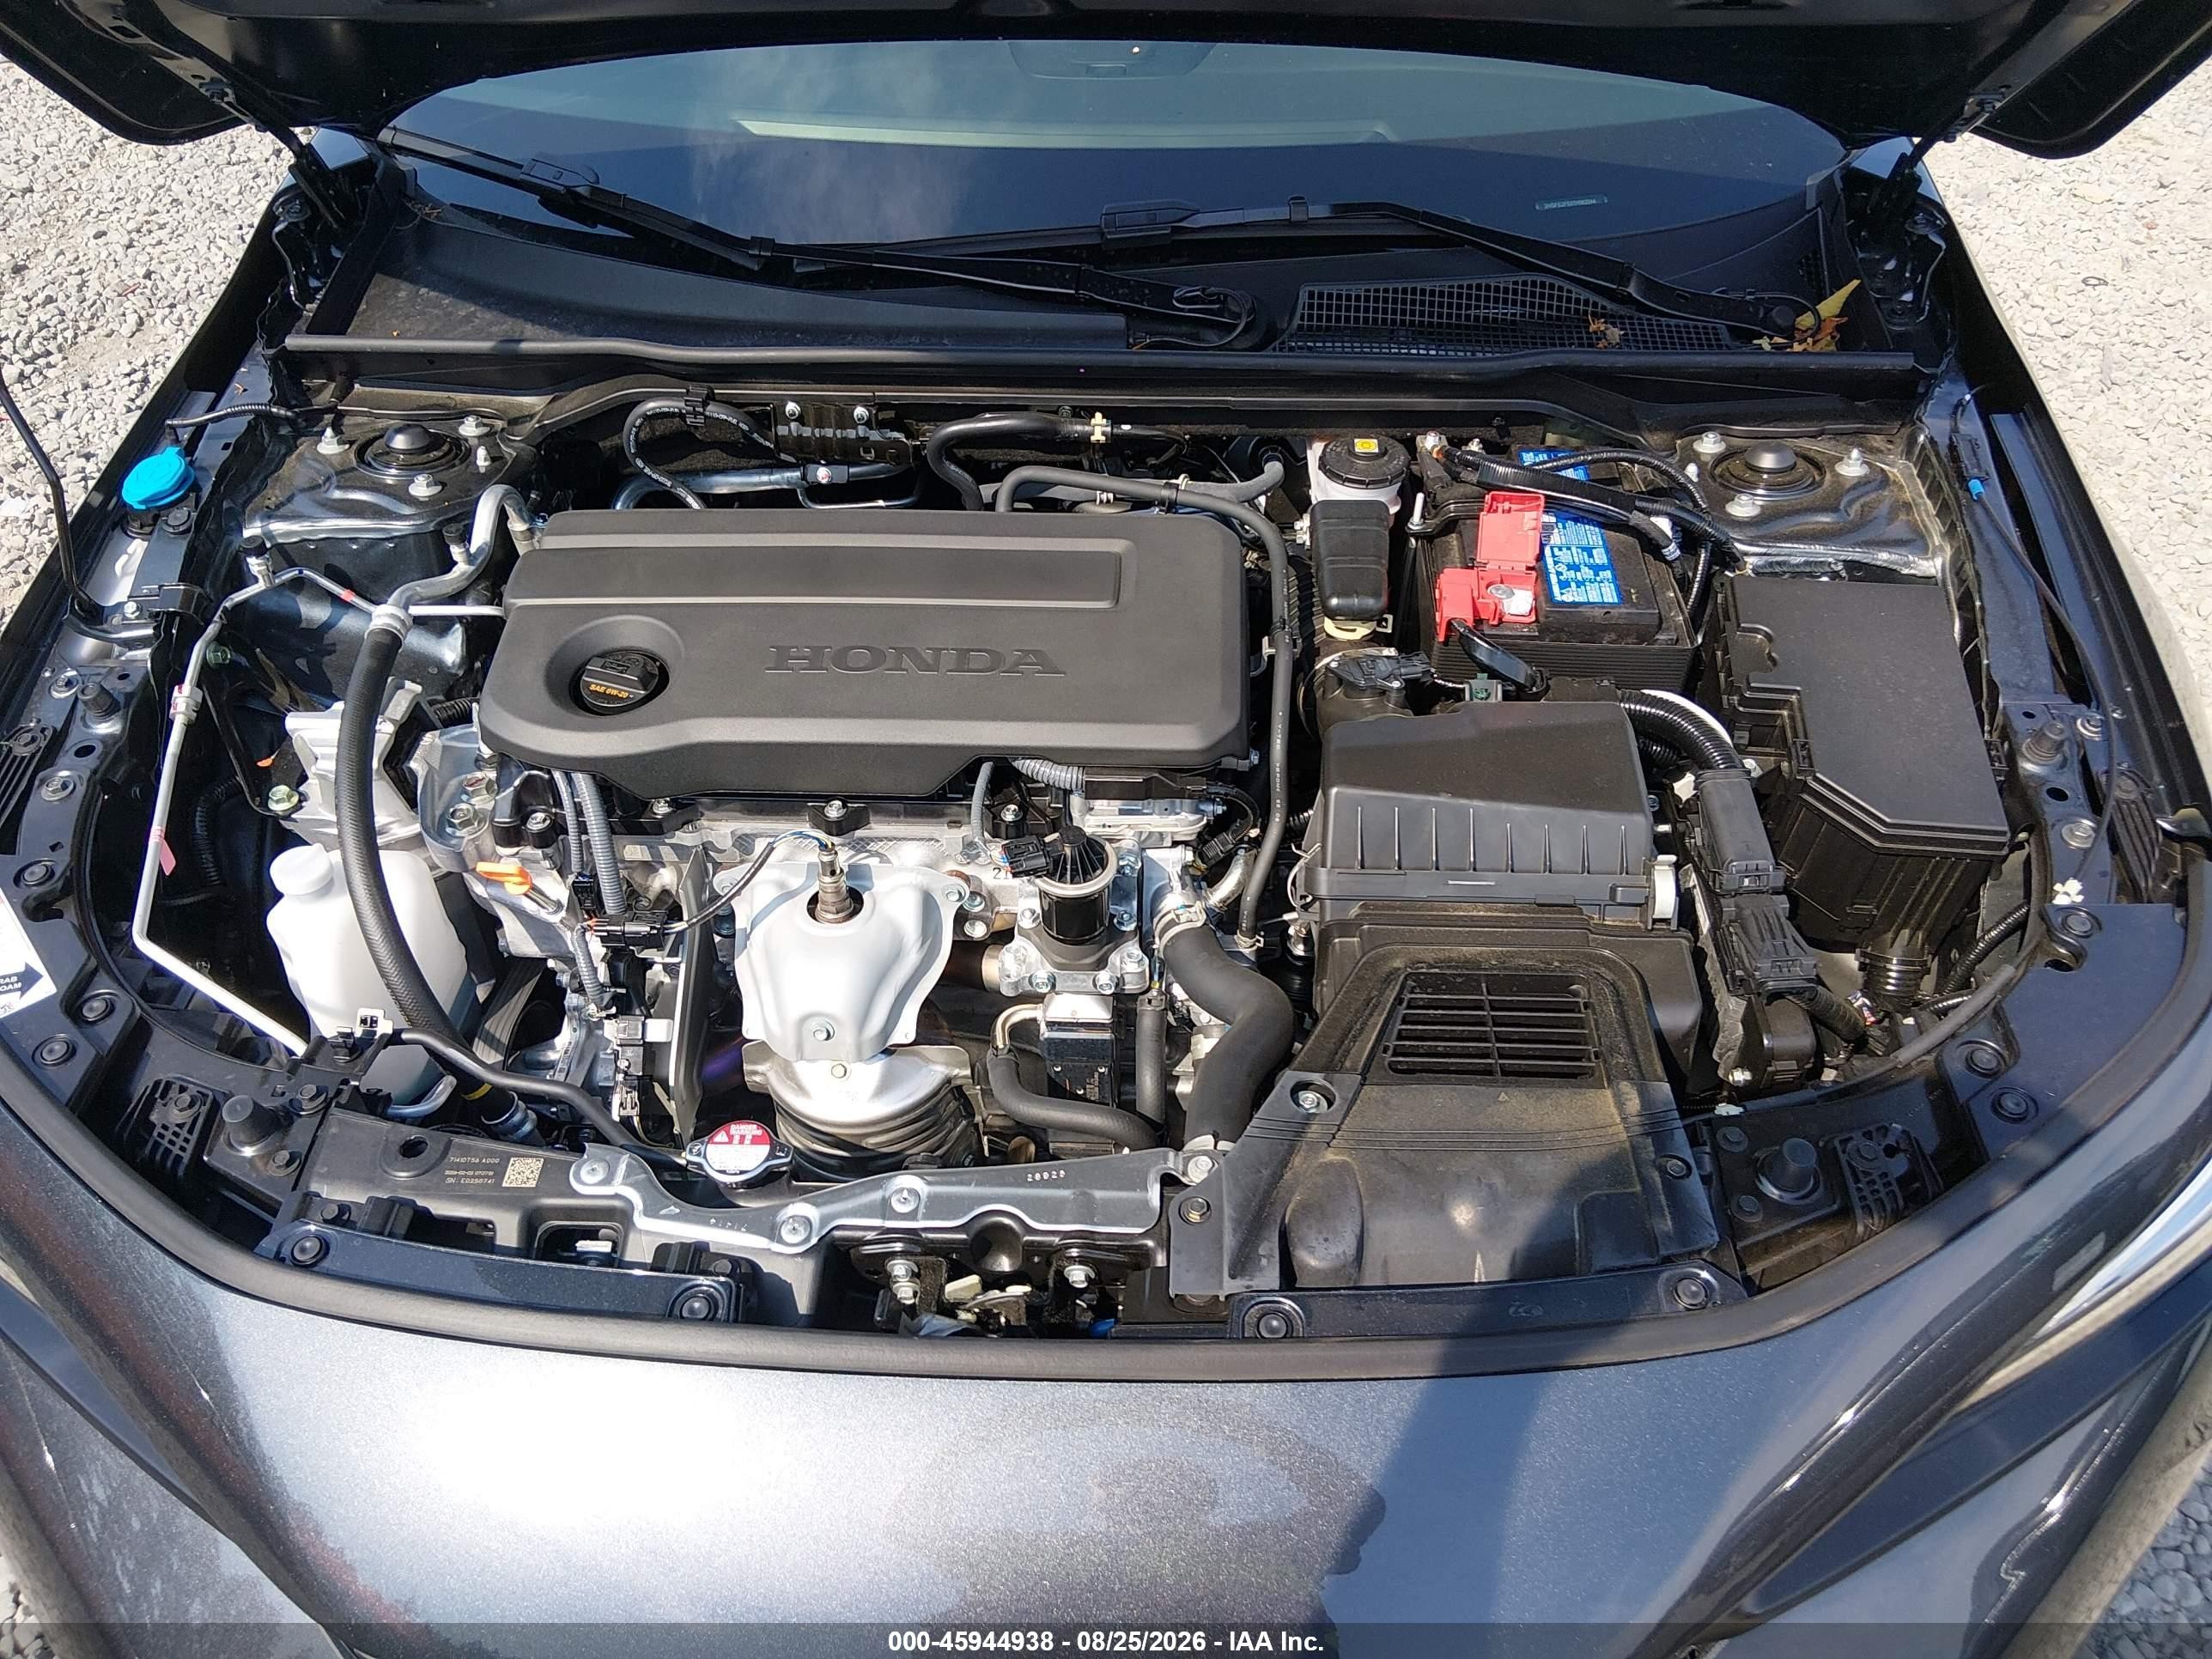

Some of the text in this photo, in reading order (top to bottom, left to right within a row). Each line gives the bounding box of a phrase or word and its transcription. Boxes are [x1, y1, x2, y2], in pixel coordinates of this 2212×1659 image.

[765, 646, 1066, 677] HONDA
[590, 684, 629, 698] SAE 0W-20
